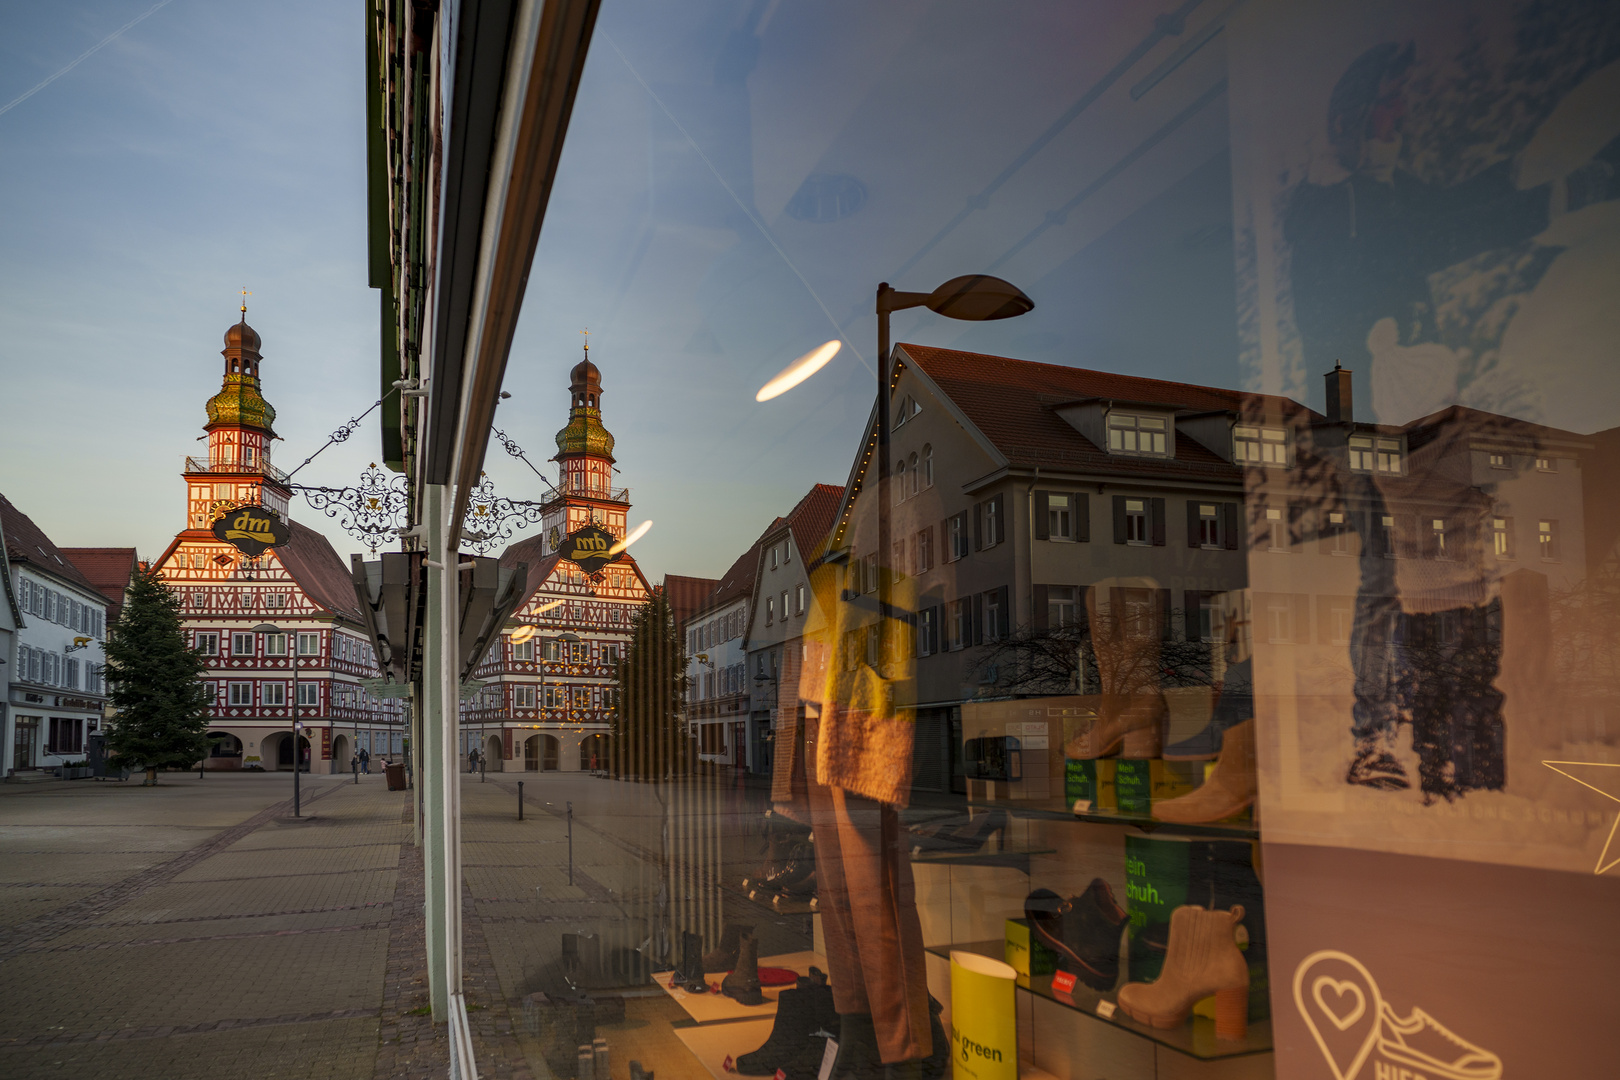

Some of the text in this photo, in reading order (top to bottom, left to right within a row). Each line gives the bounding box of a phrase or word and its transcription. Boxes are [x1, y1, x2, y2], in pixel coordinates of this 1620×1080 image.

[233, 511, 271, 533] dm
[1066, 762, 1083, 773] Mein
[1117, 763, 1135, 774] Mein
[1066, 773, 1090, 784] Schuh.
[1117, 773, 1143, 786] Schuh.
[1126, 879, 1165, 906] chuh.
[961, 1036, 1003, 1063] green
